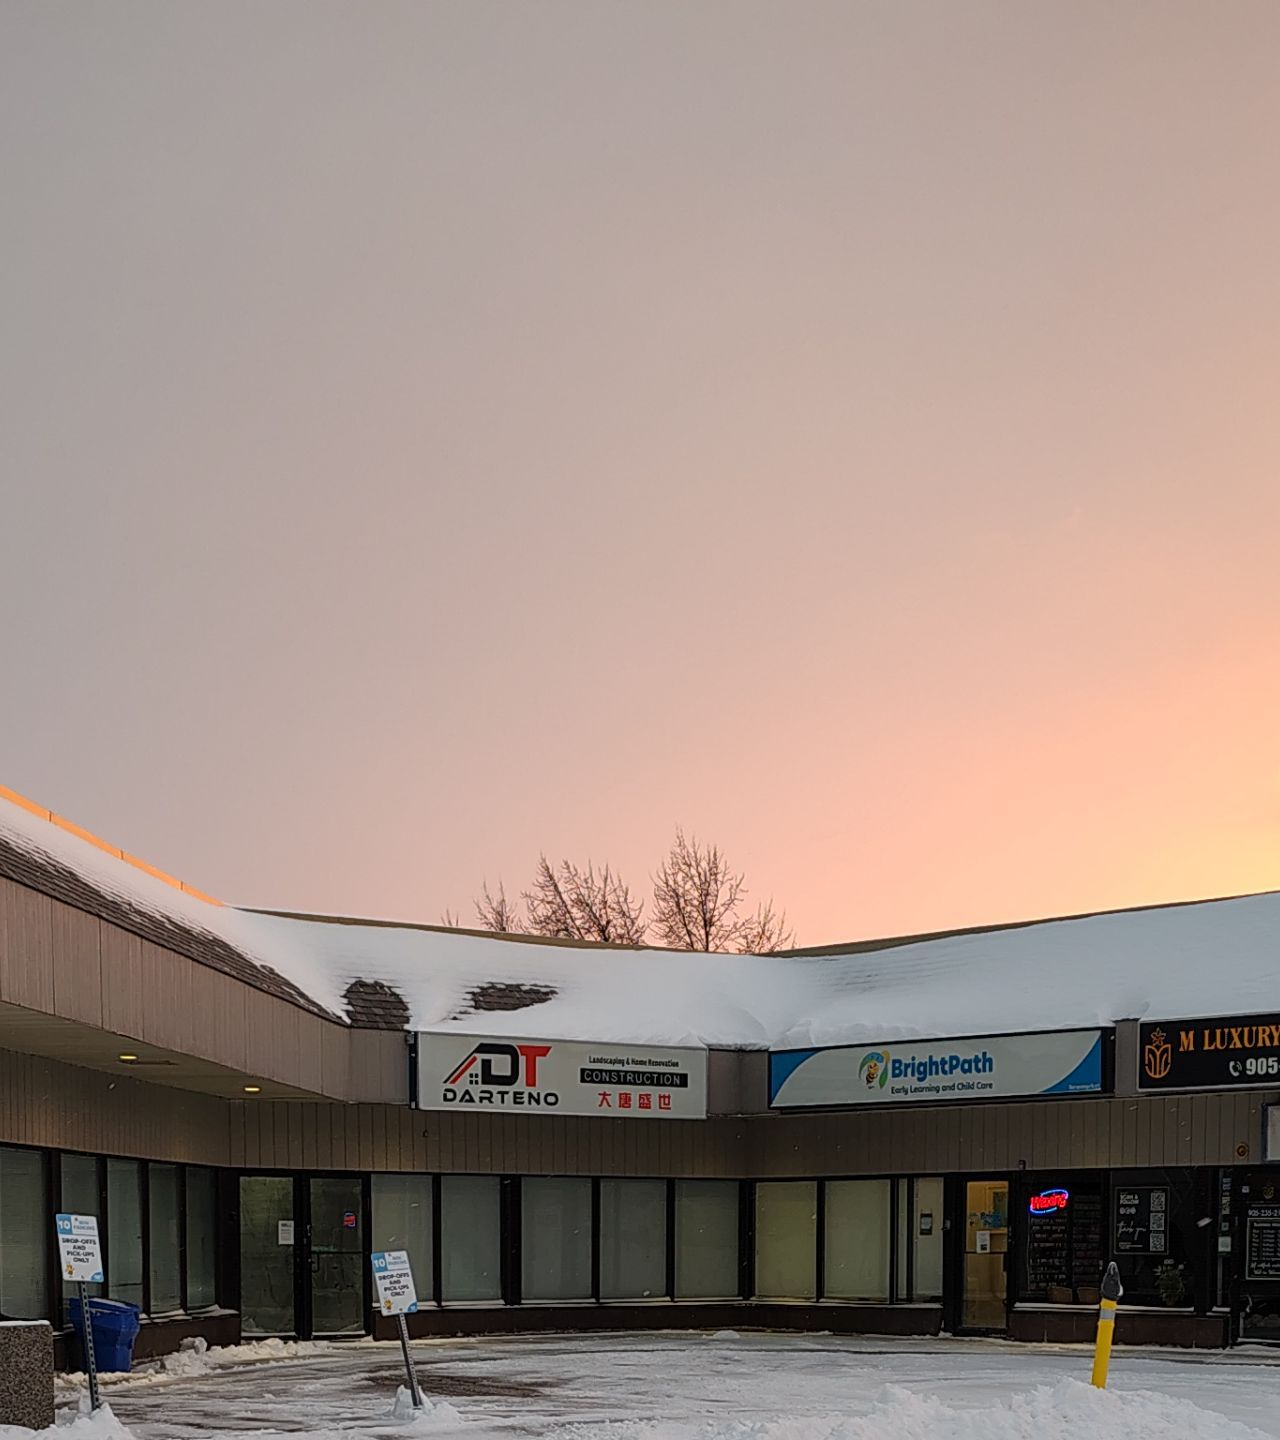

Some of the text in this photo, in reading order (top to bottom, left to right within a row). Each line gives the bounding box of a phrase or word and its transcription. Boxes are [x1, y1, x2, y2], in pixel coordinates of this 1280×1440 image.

[1179, 1030, 1194, 1052] M
[589, 1056, 625, 1067] Landscaping
[631, 1058, 647, 1066] Home
[648, 1059, 679, 1067] Renovation
[891, 1052, 993, 1082] BrightPath
[584, 1071, 680, 1085] CONSTRUCTION
[891, 1086, 909, 1095] Early
[910, 1084, 940, 1094] Learning
[942, 1083, 956, 1091] and
[957, 1082, 975, 1090] Child
[443, 1088, 559, 1106] DARTENO
[597, 1091, 672, 1110] 大唐盛世
[58, 1220, 70, 1230] 10
[374, 1258, 386, 1268] 10
[378, 1272, 409, 1280] DROP-OFFS
[383, 1284, 409, 1292] PICK-UPS
